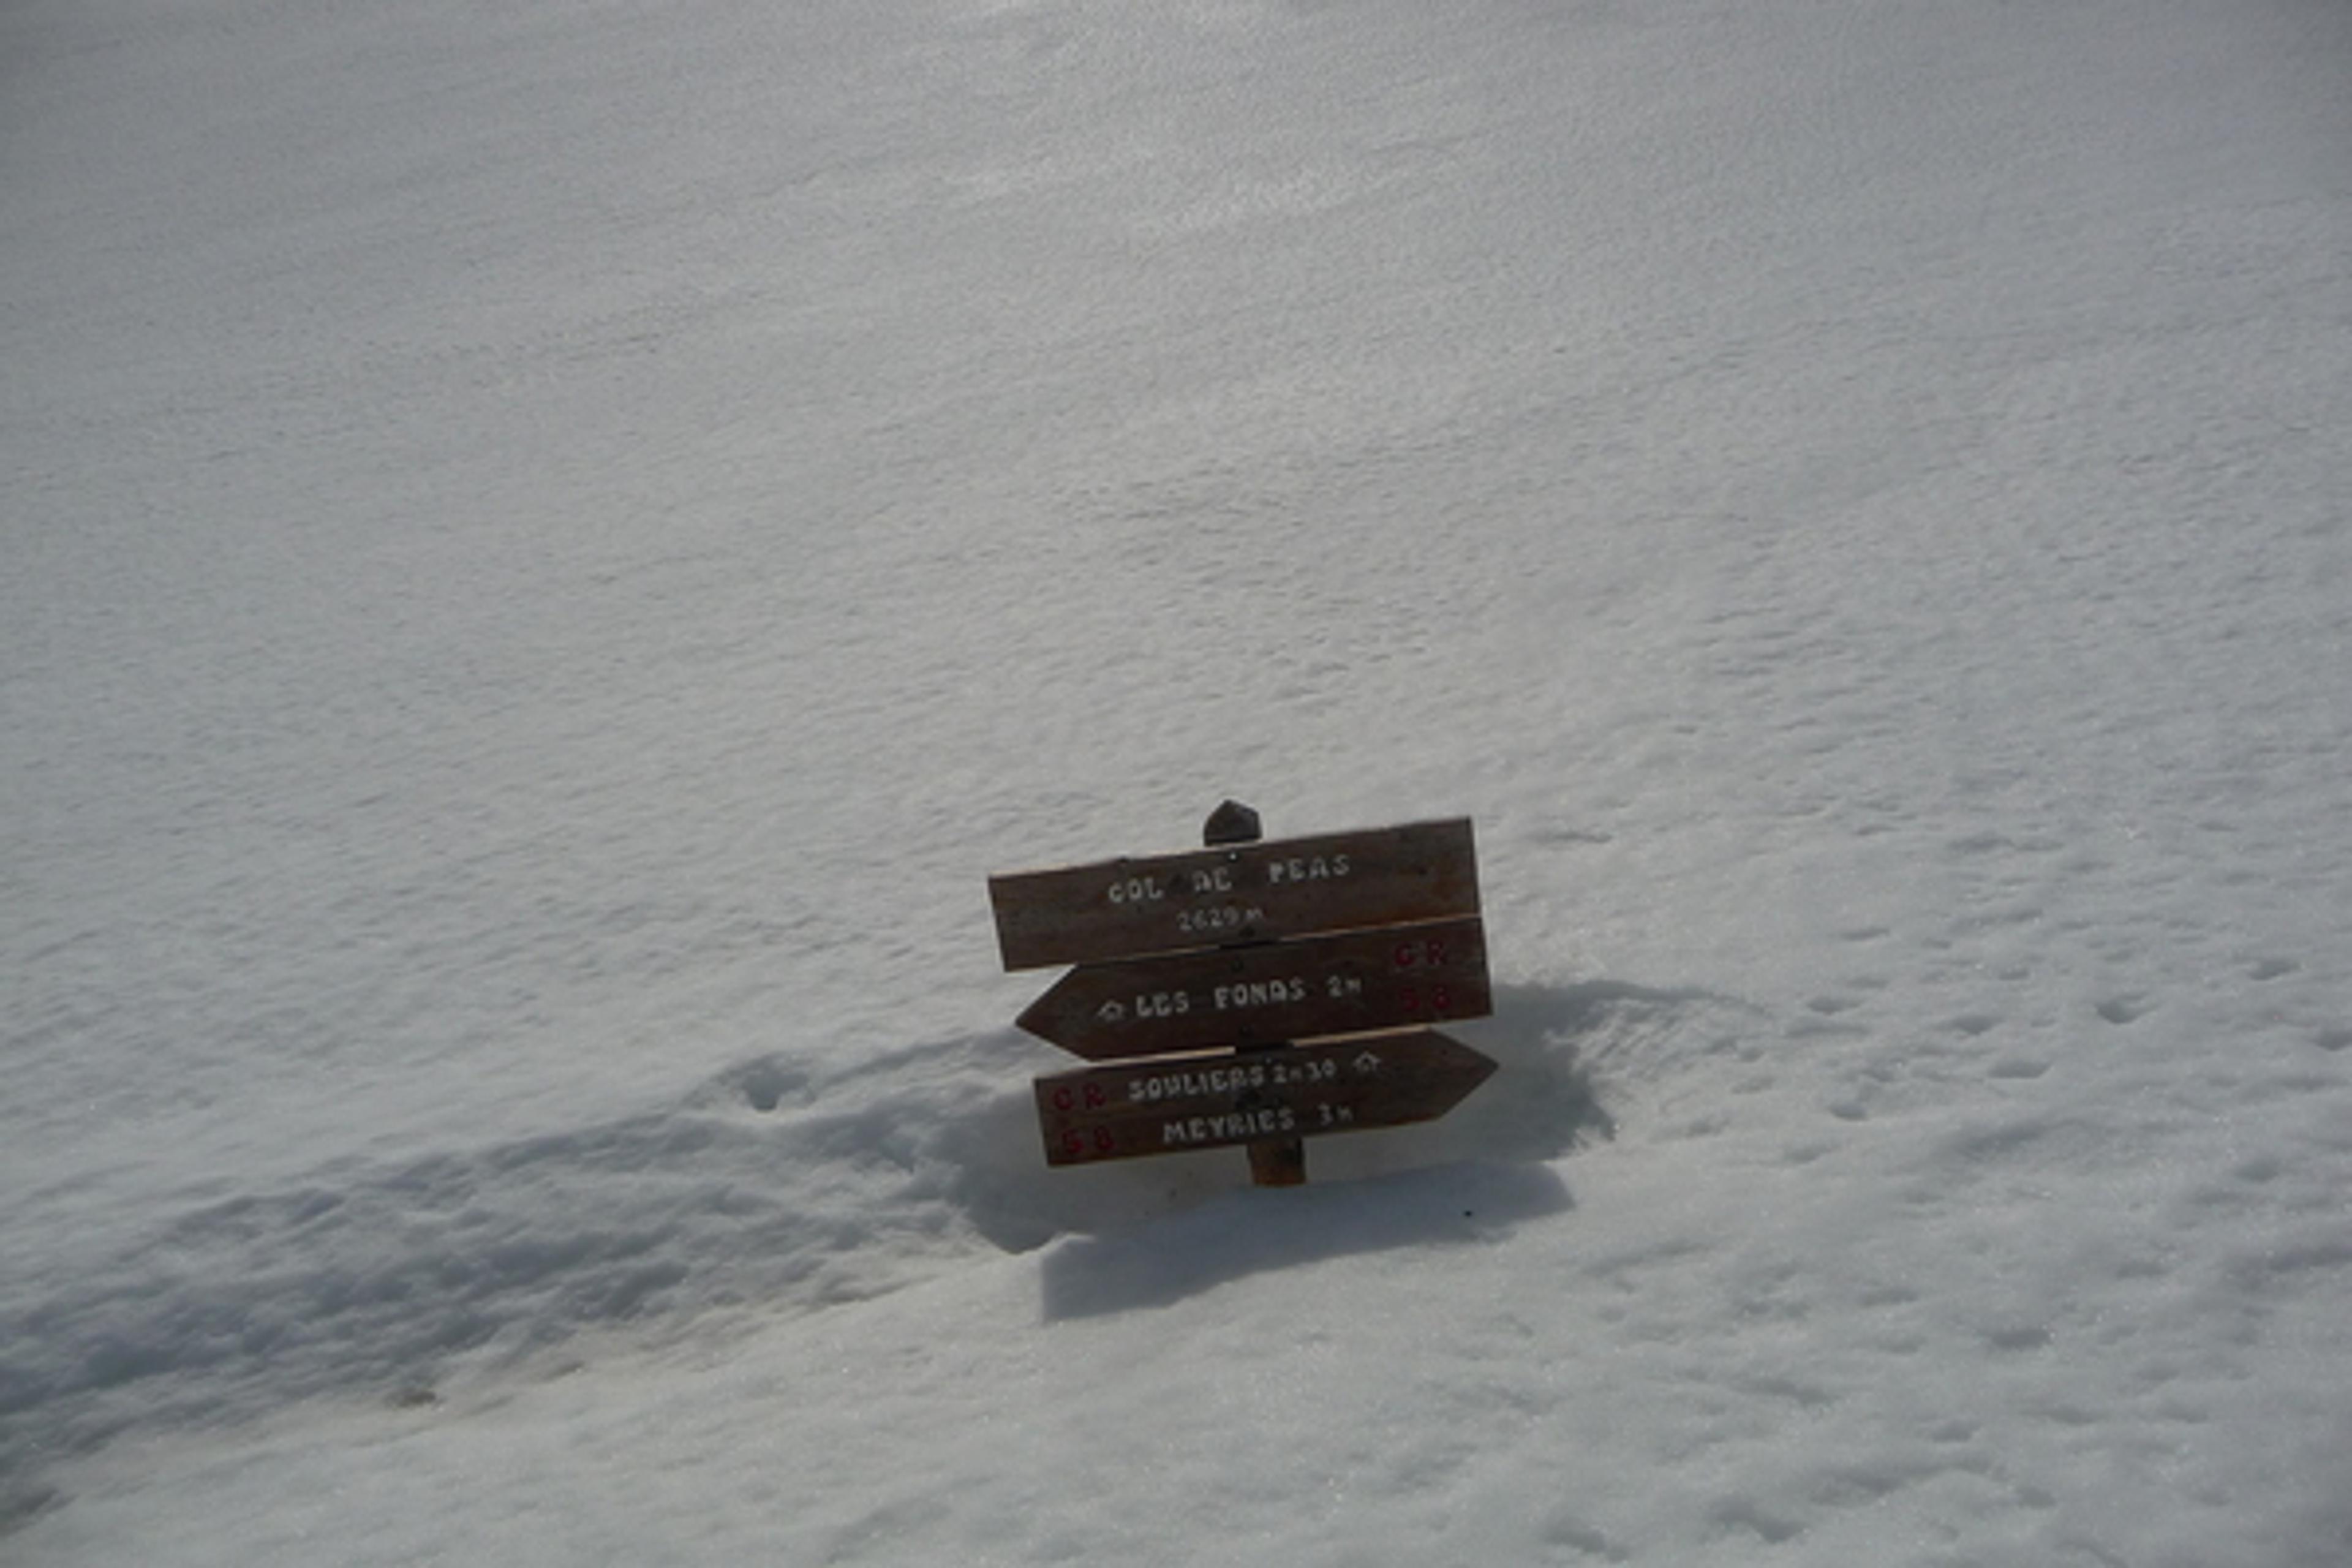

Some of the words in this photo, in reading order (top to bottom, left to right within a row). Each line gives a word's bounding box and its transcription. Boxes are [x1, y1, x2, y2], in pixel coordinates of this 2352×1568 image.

[1107, 877, 1163, 903] COL
[1192, 866, 1232, 892] DE
[1268, 854, 1349, 884] PEAS
[1394, 939, 1449, 967] GR
[1135, 990, 1189, 1017] LES
[1214, 976, 1305, 1009] FONDS
[1053, 1082, 1108, 1111] GR
[1128, 1064, 1266, 1102] SOULIERS
[1163, 1107, 1296, 1144] MEYRIES
